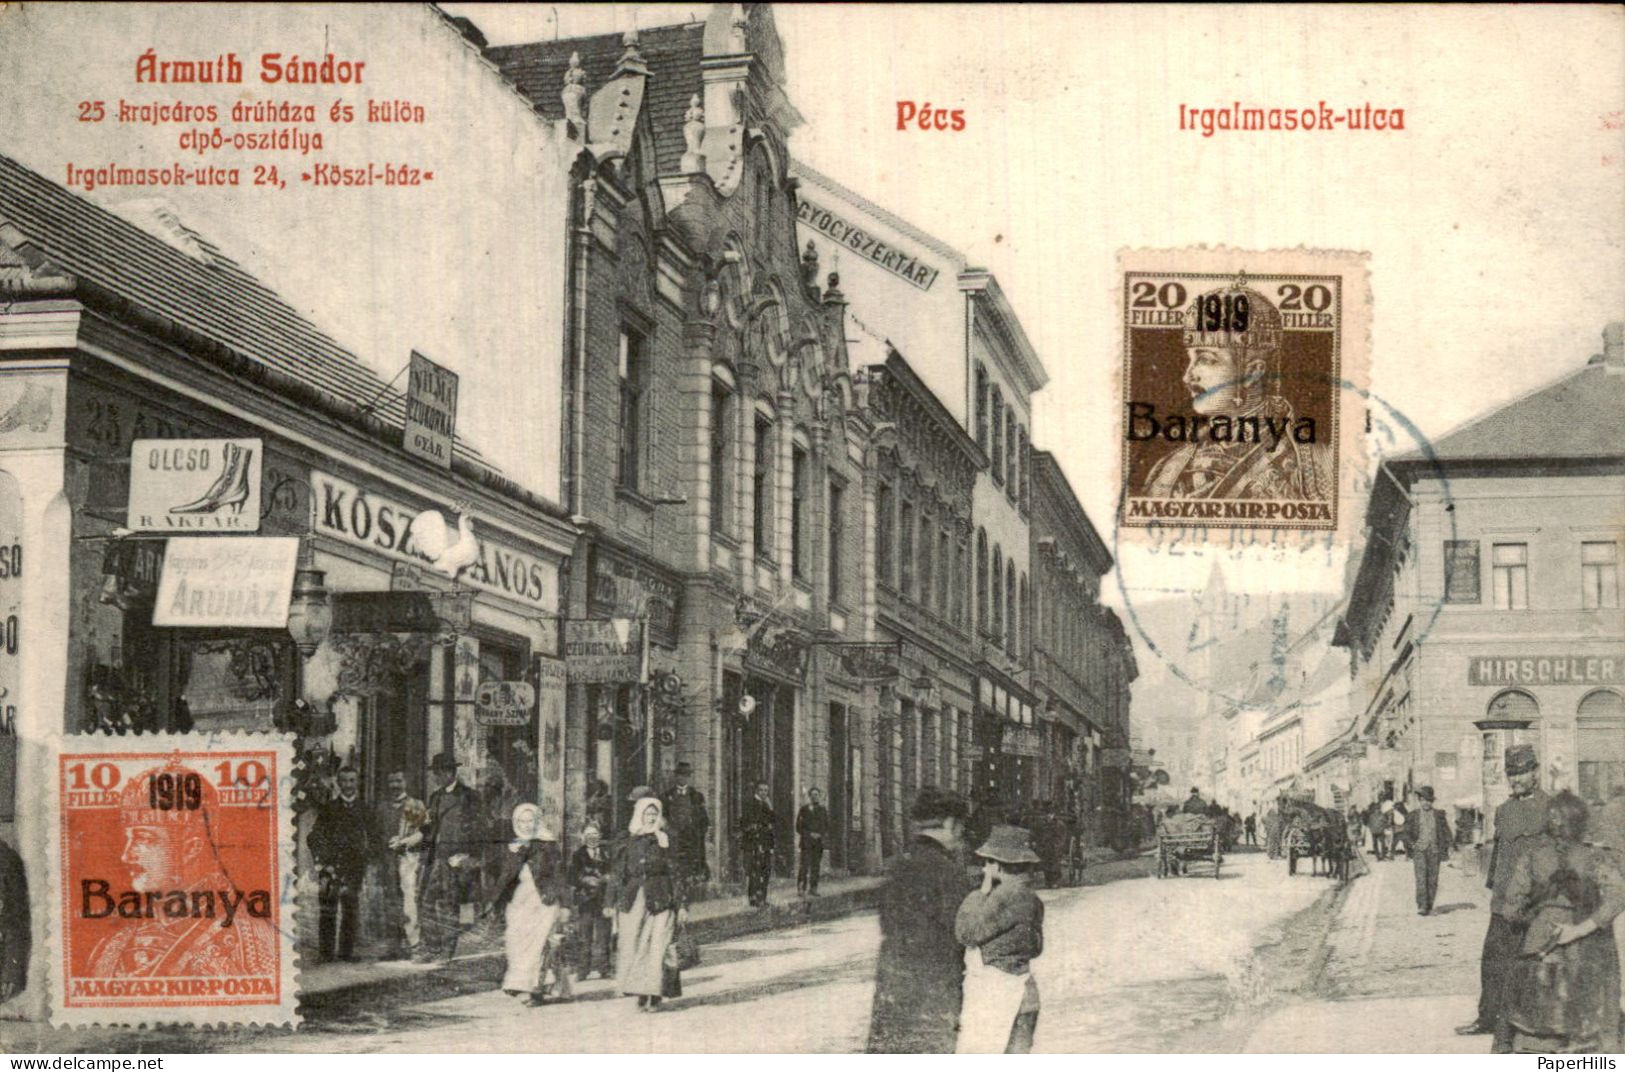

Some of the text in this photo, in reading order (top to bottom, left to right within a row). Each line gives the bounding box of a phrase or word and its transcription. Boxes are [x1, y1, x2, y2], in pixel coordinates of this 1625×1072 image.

[136, 48, 366, 84] Ármuth Sándor
[78, 98, 426, 126] 25 krajcáros árúháza és külön
[896, 100, 967, 132] Pécs
[1179, 101, 1405, 138] Irgalmasok-utca
[179, 127, 324, 155] cipő-osztálya
[66, 162, 240, 191] Irgalmasok-utca
[253, 164, 287, 190] 24,
[1132, 282, 1187, 309] 20
[1278, 284, 1332, 312] 20
[1197, 294, 1250, 332] 1919
[1128, 402, 1317, 452] Baranya
[1129, 500, 1222, 518] MAGYAR
[1479, 660, 1615, 682] HIRSCHLER
[68, 762, 121, 794] 10
[214, 761, 267, 788] 10
[149, 773, 202, 812] 1919
[81, 879, 272, 928] Baranya
[73, 978, 165, 998] MAGYAR
